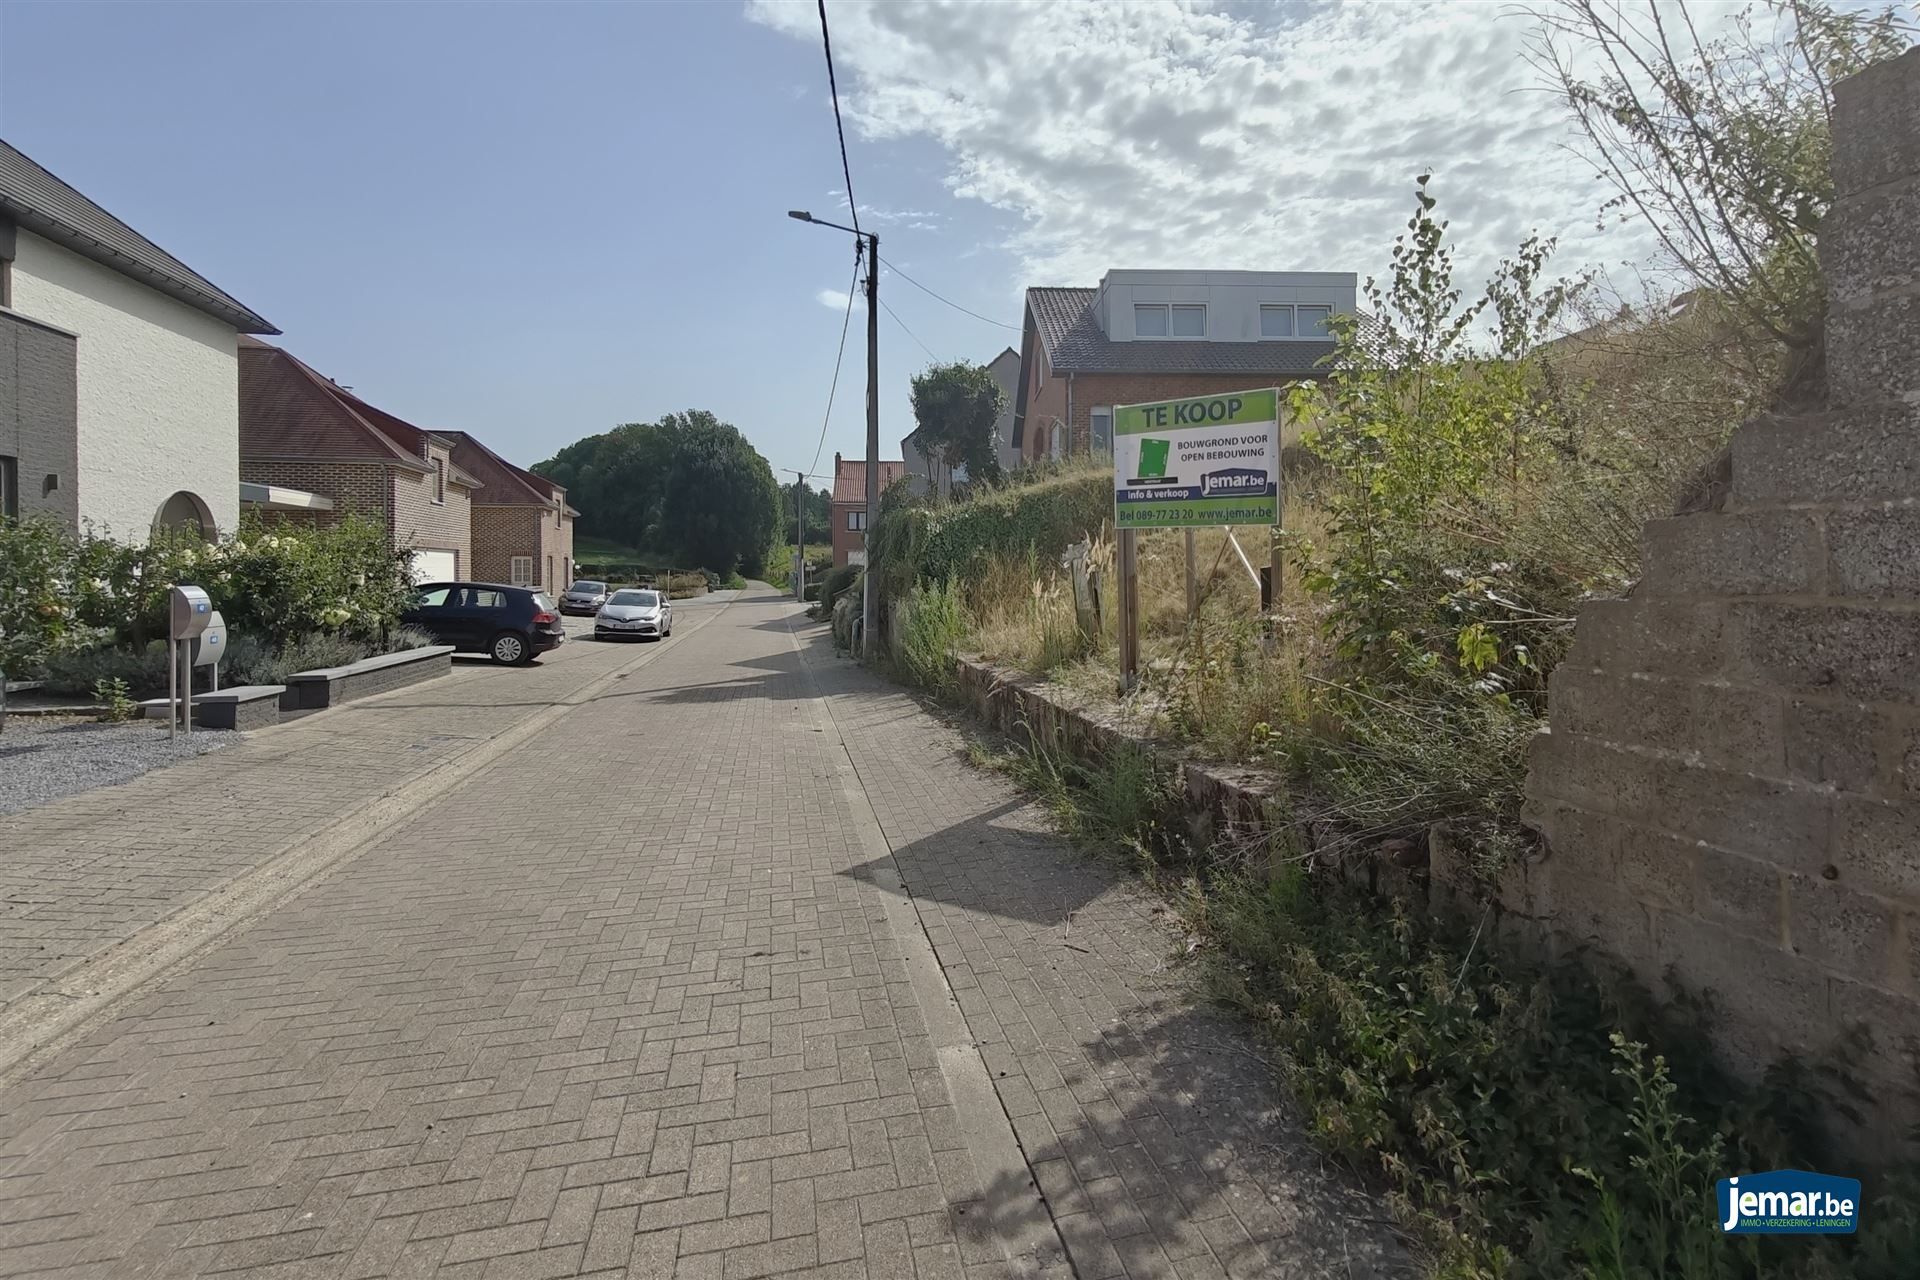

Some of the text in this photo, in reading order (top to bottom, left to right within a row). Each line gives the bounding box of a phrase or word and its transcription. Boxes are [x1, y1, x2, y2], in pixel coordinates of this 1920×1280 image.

[1142, 398, 1242, 427] TE KOOP
[1178, 434, 1268, 450] BOUWGROND VOOR
[1181, 448, 1265, 462] OPEN BEBOUWING
[1203, 473, 1264, 495] jemar.be
[1146, 489, 1153, 499] &
[1154, 488, 1189, 498] verkoop
[1120, 506, 1272, 521] Bel 089-77 23 20 www.jemar.be
